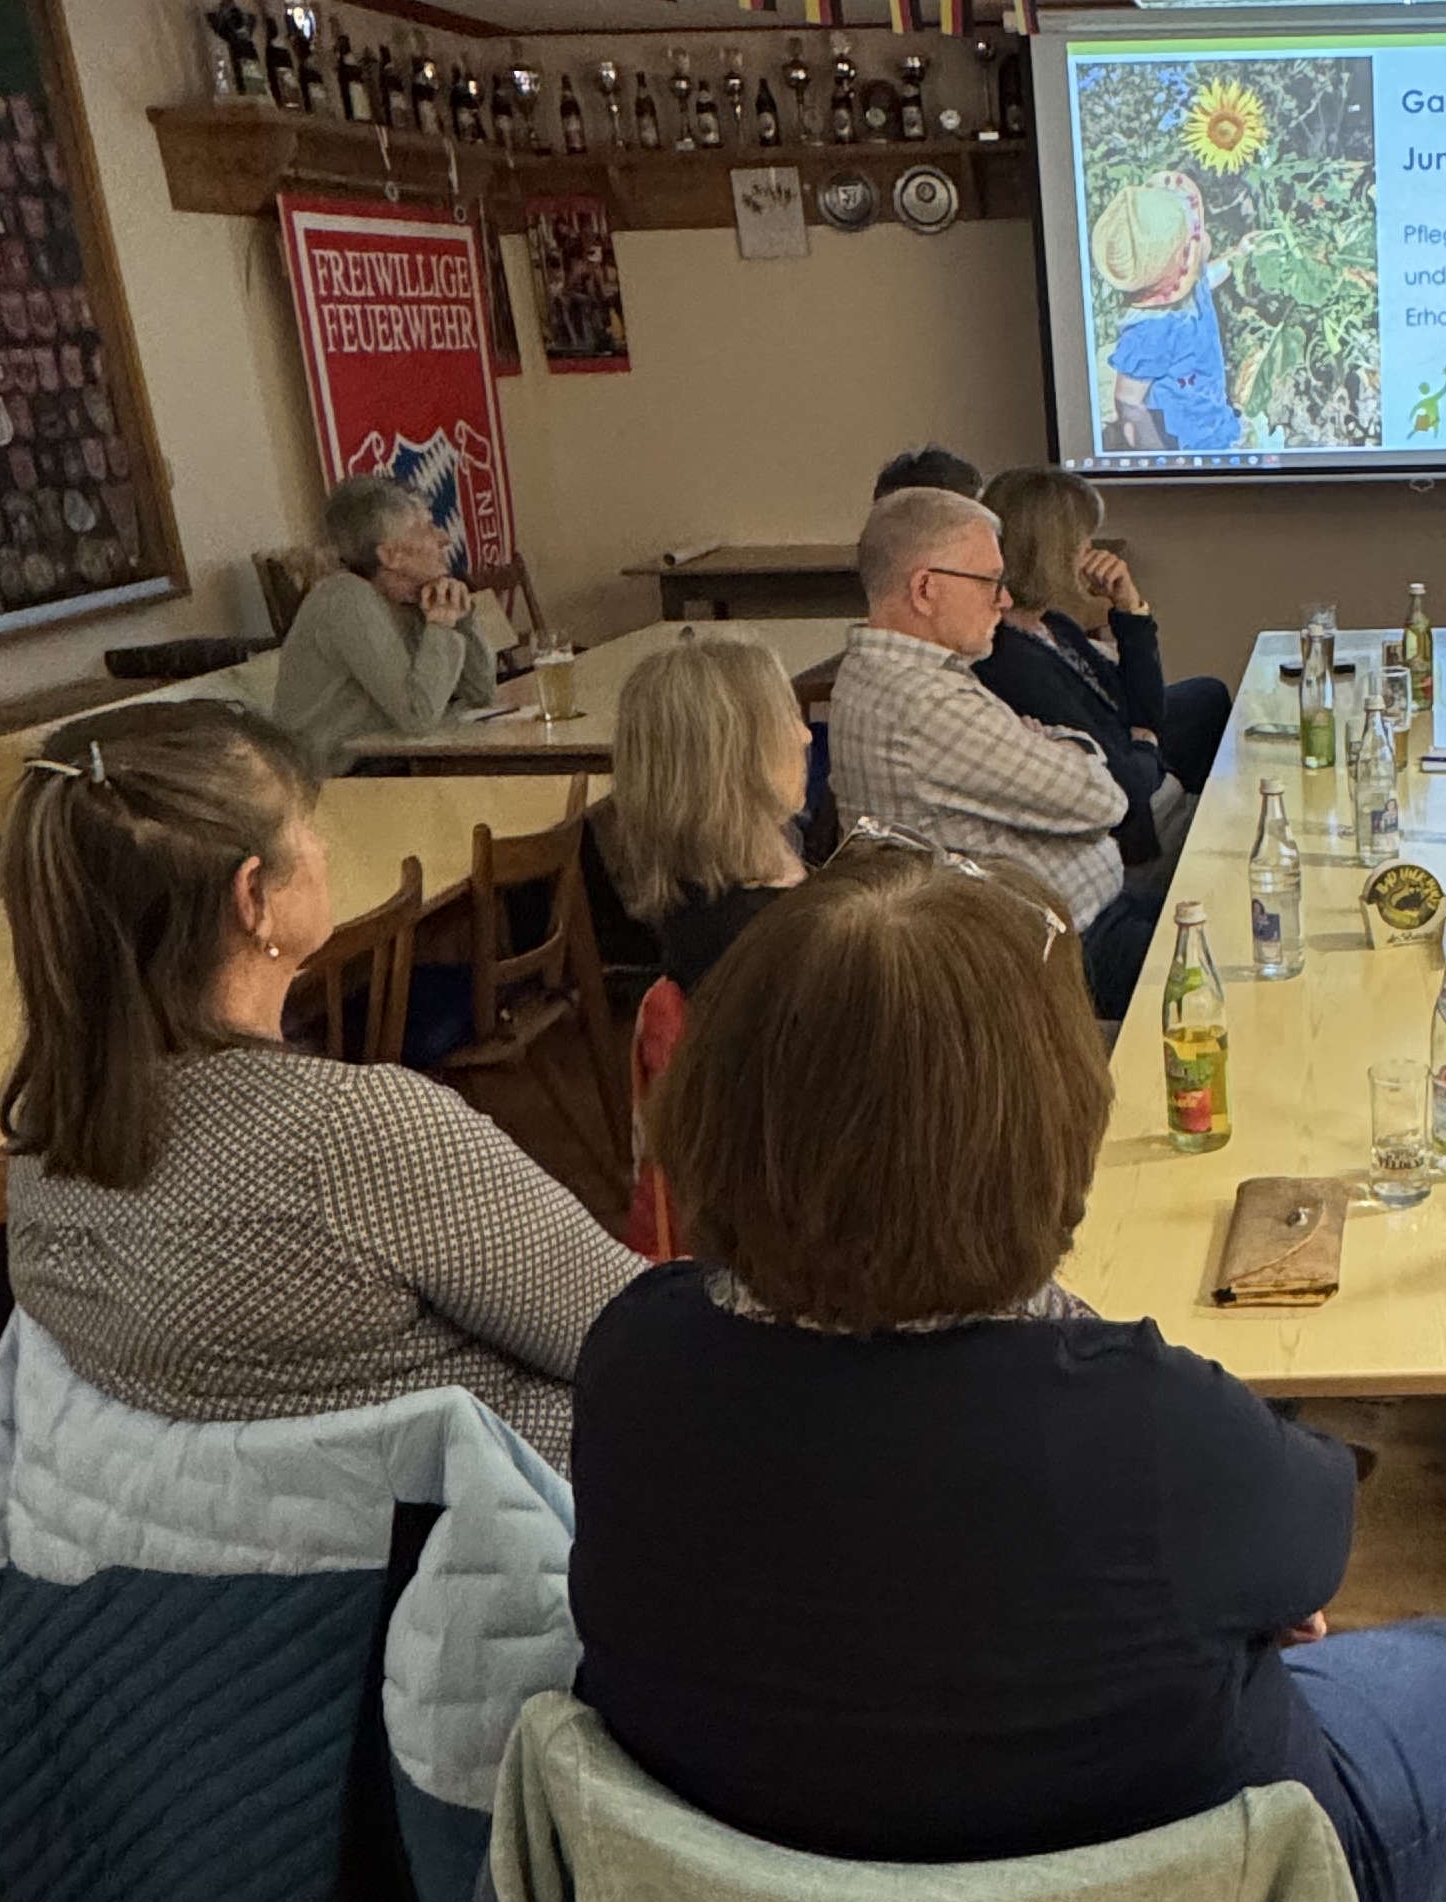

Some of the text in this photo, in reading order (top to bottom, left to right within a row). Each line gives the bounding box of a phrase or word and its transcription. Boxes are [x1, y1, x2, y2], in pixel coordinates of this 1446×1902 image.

[312, 249, 472, 299] FREIWILLIGE
[1404, 266, 1446, 286] und
[320, 304, 478, 352] FEUERWEHR
